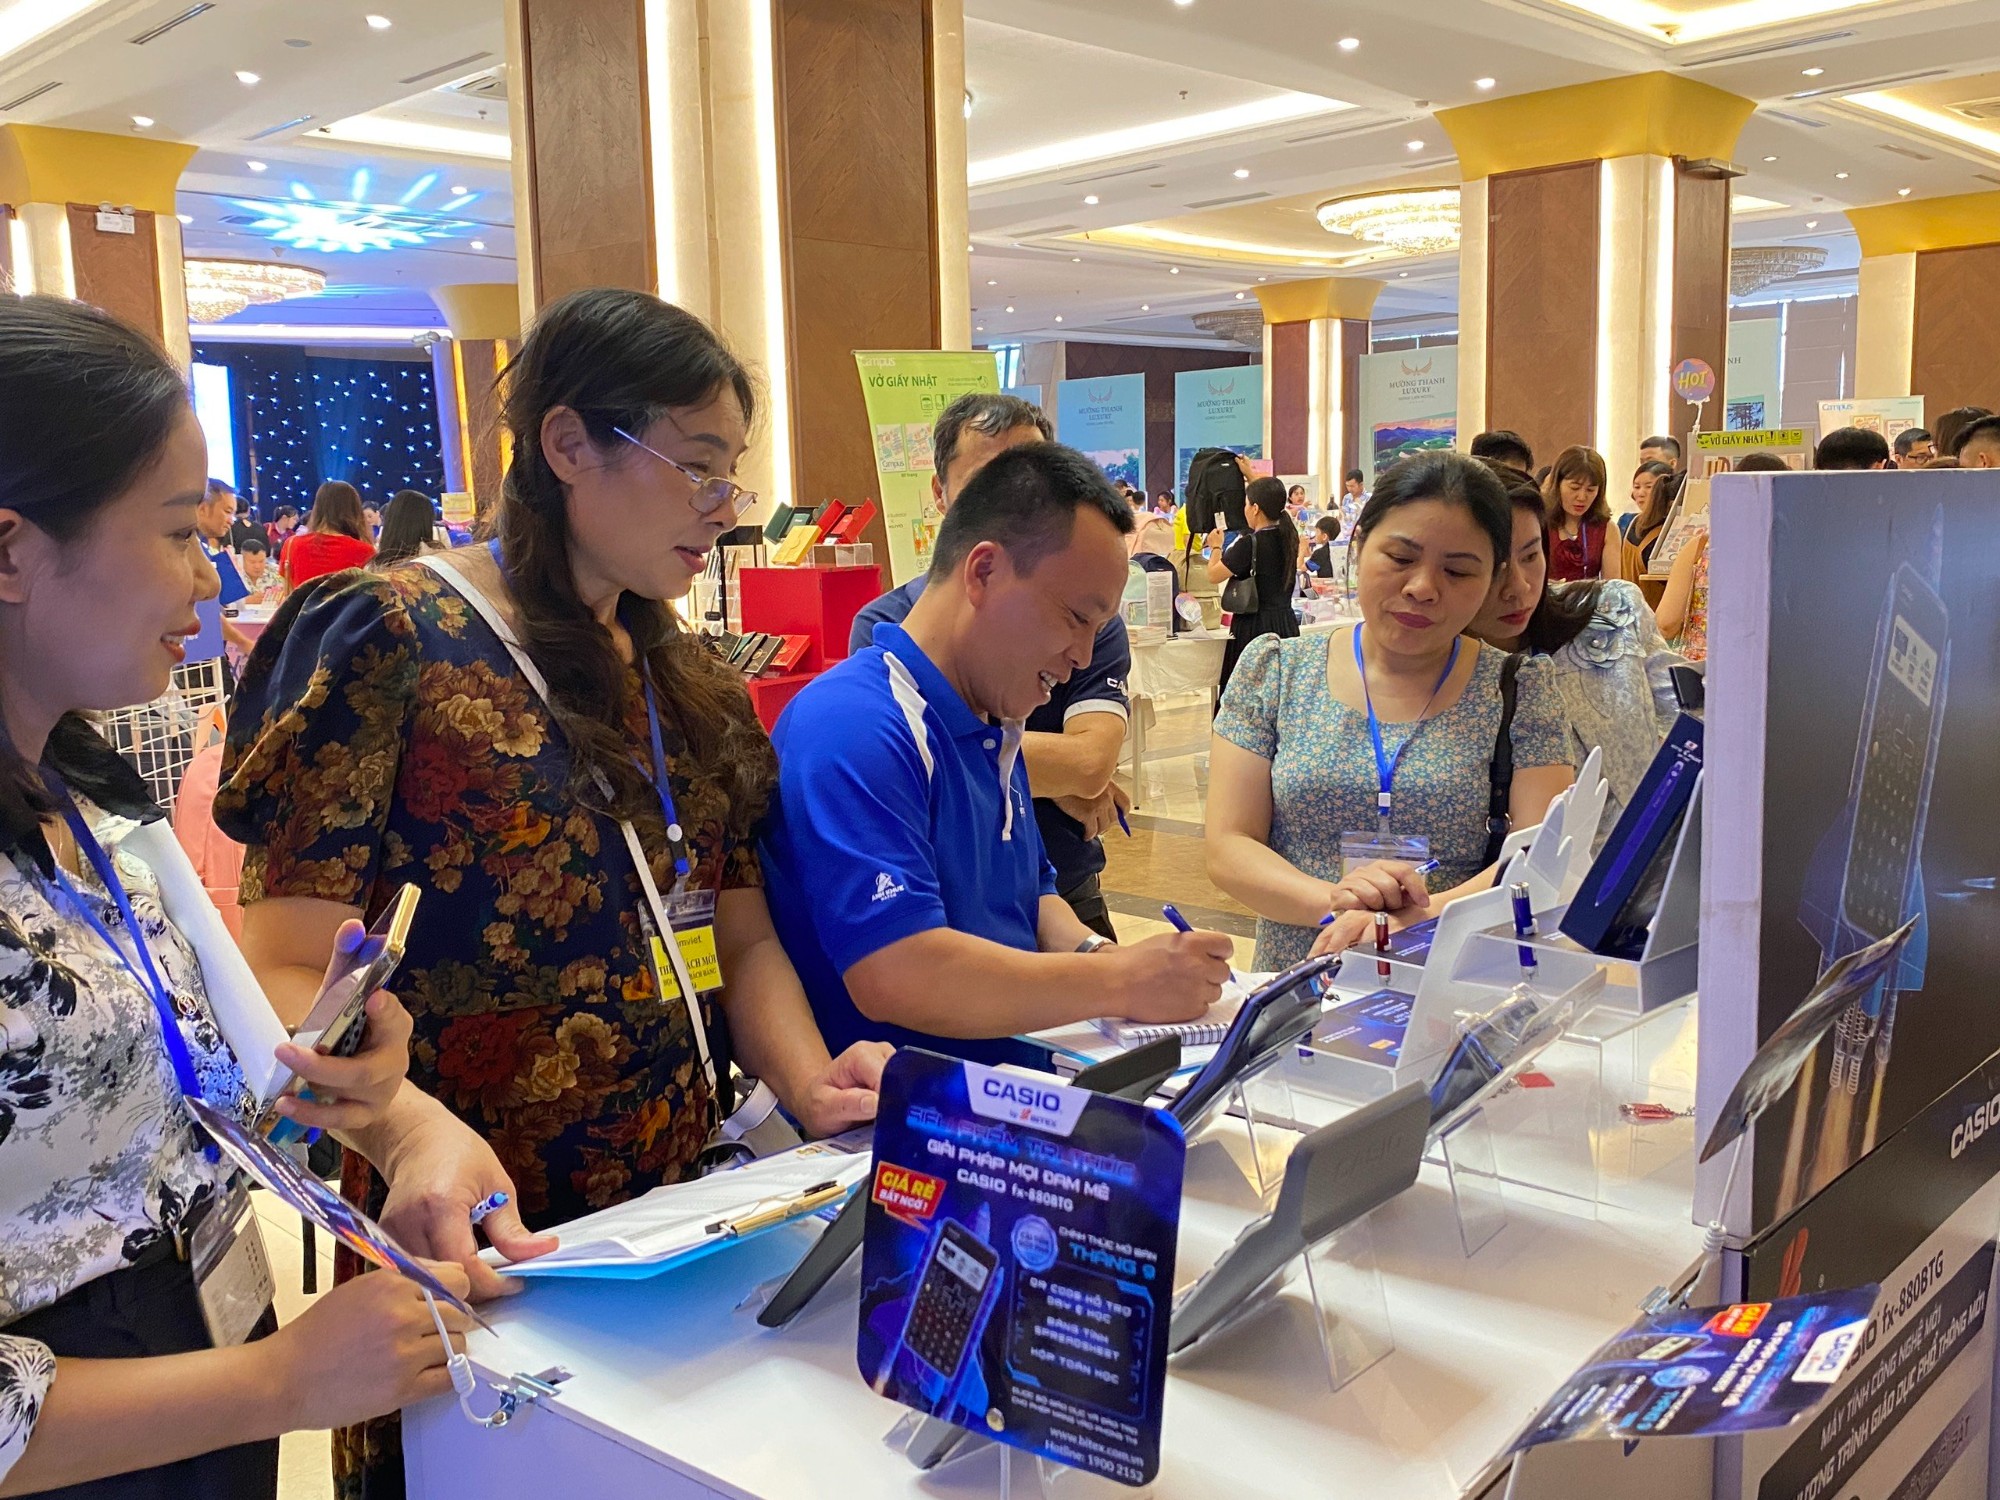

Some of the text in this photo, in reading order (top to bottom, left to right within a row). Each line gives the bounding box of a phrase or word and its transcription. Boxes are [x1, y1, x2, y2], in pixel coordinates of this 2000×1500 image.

[869, 373, 885, 387] VỞ
[887, 373, 909, 387] GIẤY
[912, 374, 937, 389] NHẬT
[1418, 377, 1445, 386] THANH
[1678, 370, 1708, 390] HOT
[1402, 386, 1431, 395] LUXURY
[1101, 405, 1123, 413] THANH
[1208, 406, 1234, 414] LUXURY
[1222, 397, 1246, 406] THANH
[1822, 403, 1853, 412] Campus
[1088, 413, 1112, 421] LUXURY
[882, 460, 904, 469] Campus
[983, 1078, 1061, 1112] CASIO
[1951, 1093, 2000, 1159] CASIO
[956, 1168, 1007, 1194] CASIO
[958, 1147, 1006, 1170] PHÁP
[1008, 1160, 1039, 1183] MỌI
[1083, 1179, 1111, 1201] MÊ
[882, 1171, 936, 1200] GIÁ RẺ
[1882, 1249, 1944, 1335] fx-880BTG
[1820, 1302, 1942, 1451] MÁY TÍNH CÔNG NGHỆ MỚI
[1837, 1423, 1869, 1471] TRÌNH
[1870, 1390, 1896, 1435] GIÁO
[1896, 1365, 1917, 1406] DỤC
[1938, 1309, 1968, 1359] THÔNG
[1967, 1288, 1987, 1324] MỚI
